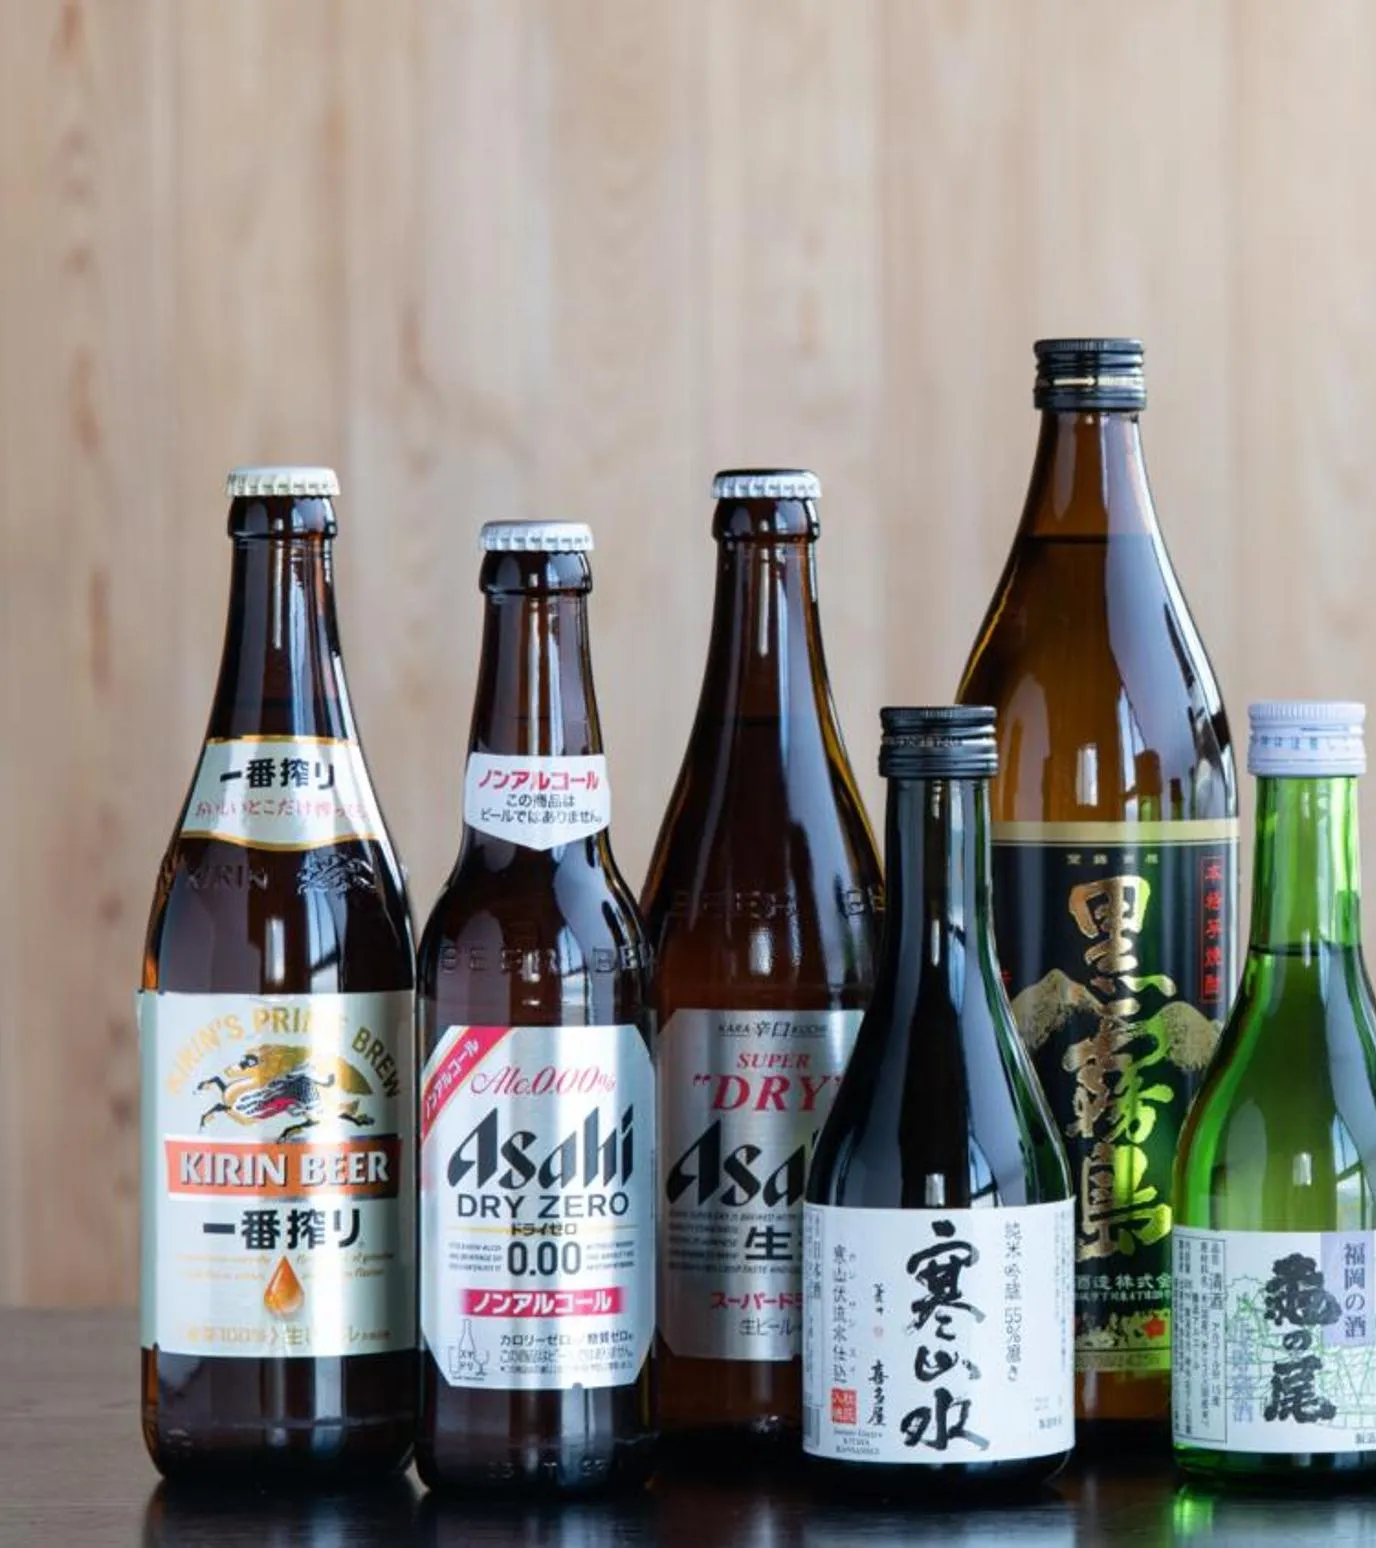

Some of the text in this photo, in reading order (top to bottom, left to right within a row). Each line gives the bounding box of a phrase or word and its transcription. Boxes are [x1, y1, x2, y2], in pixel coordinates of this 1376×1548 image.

[219, 757, 335, 790] 一番搾り
[478, 770, 600, 792] ノンアルコール
[505, 794, 576, 809] この商品は
[254, 1006, 332, 1035] PRI
[350, 1026, 401, 1099] BREW
[735, 1052, 812, 1070] SUPER
[1061, 874, 1178, 1262] 黒霧島
[447, 1103, 634, 1190] Asahi
[668, 1119, 812, 1208] Asa
[179, 1149, 390, 1186] KIRIN BEER
[457, 1191, 630, 1219] DRY ZERO
[202, 1207, 362, 1250] 一番搾り
[510, 1222, 578, 1237] ドライゼロ
[745, 1225, 793, 1261] 生
[506, 1240, 583, 1277] 0.00
[472, 1290, 613, 1316] ノンアルコール
[1343, 1242, 1367, 1338] 福岡の酒
[900, 1218, 991, 1451] 寒山水
